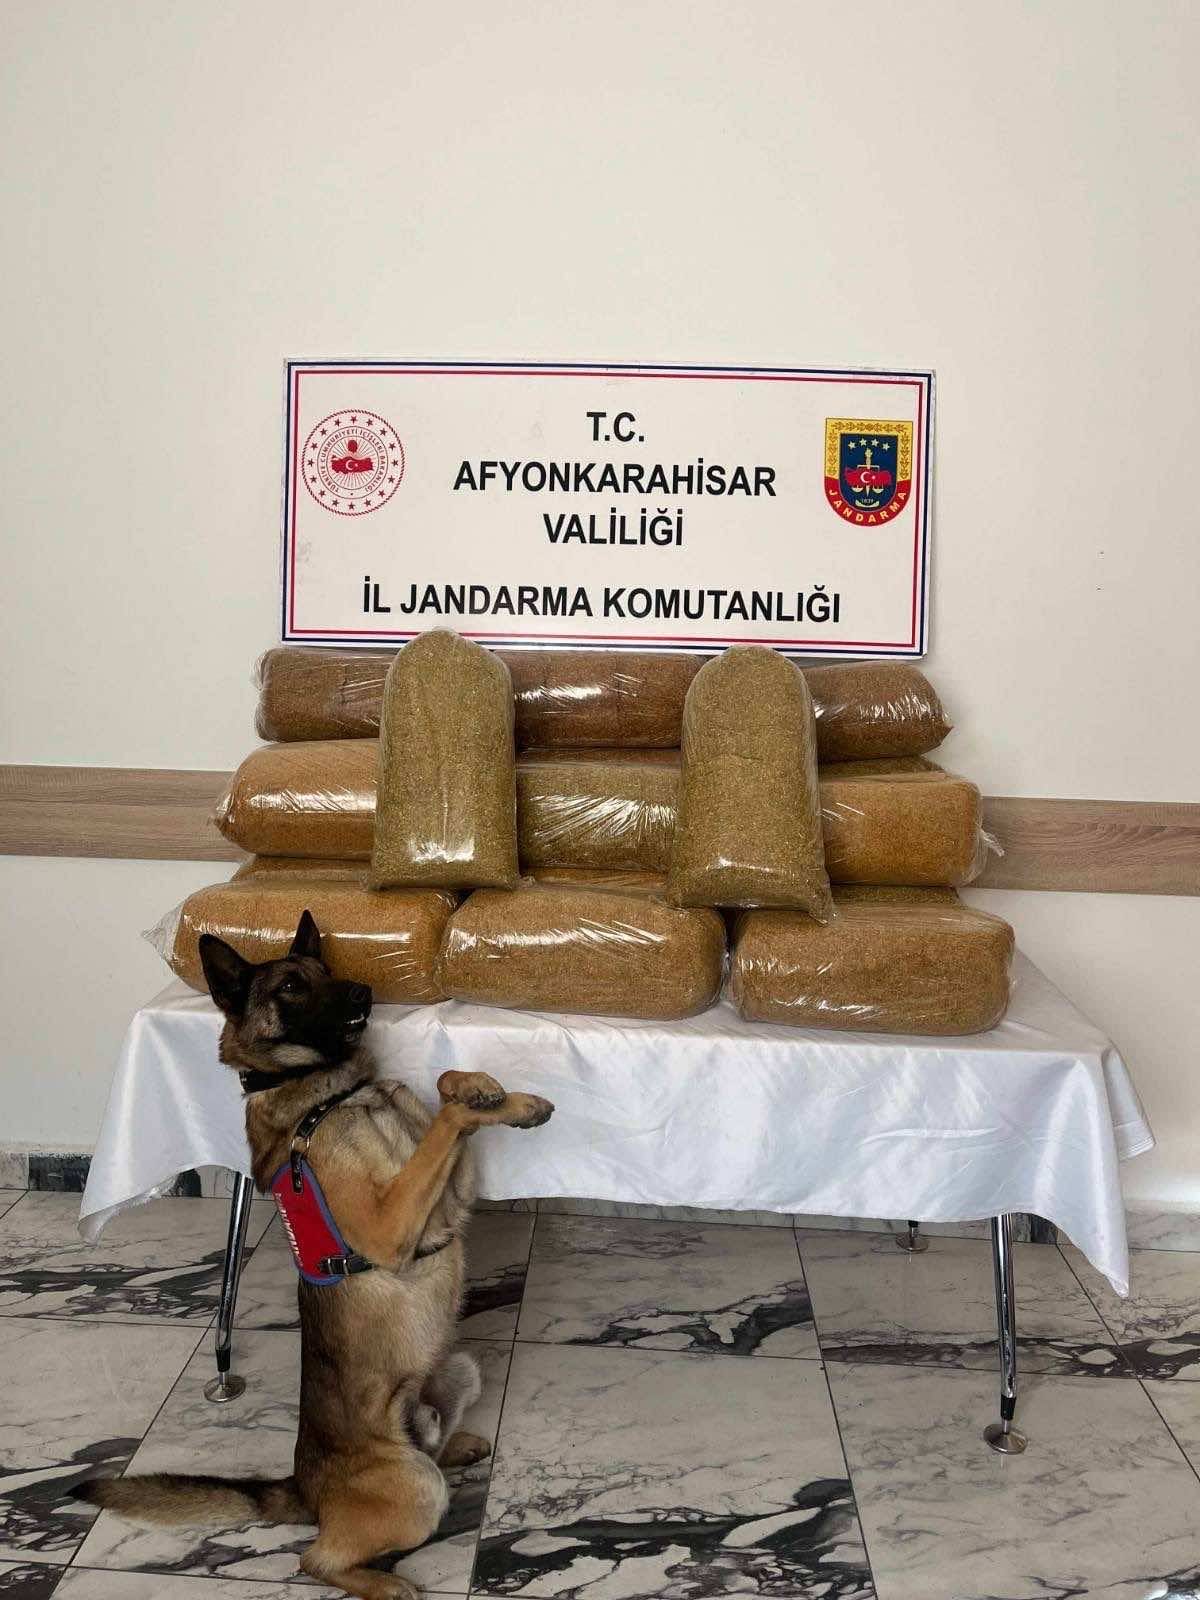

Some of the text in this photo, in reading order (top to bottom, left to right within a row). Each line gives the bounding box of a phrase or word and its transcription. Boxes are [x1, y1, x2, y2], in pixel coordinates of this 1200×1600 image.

[586, 411, 645, 442] T.C.
[453, 458, 777, 497] AFYONKARAHİSAR
[829, 489, 907, 523] JANDARMA
[543, 507, 683, 546] VALİLİĞİ
[364, 576, 840, 623] İL JANDARMA KOMUTANLIĞI
